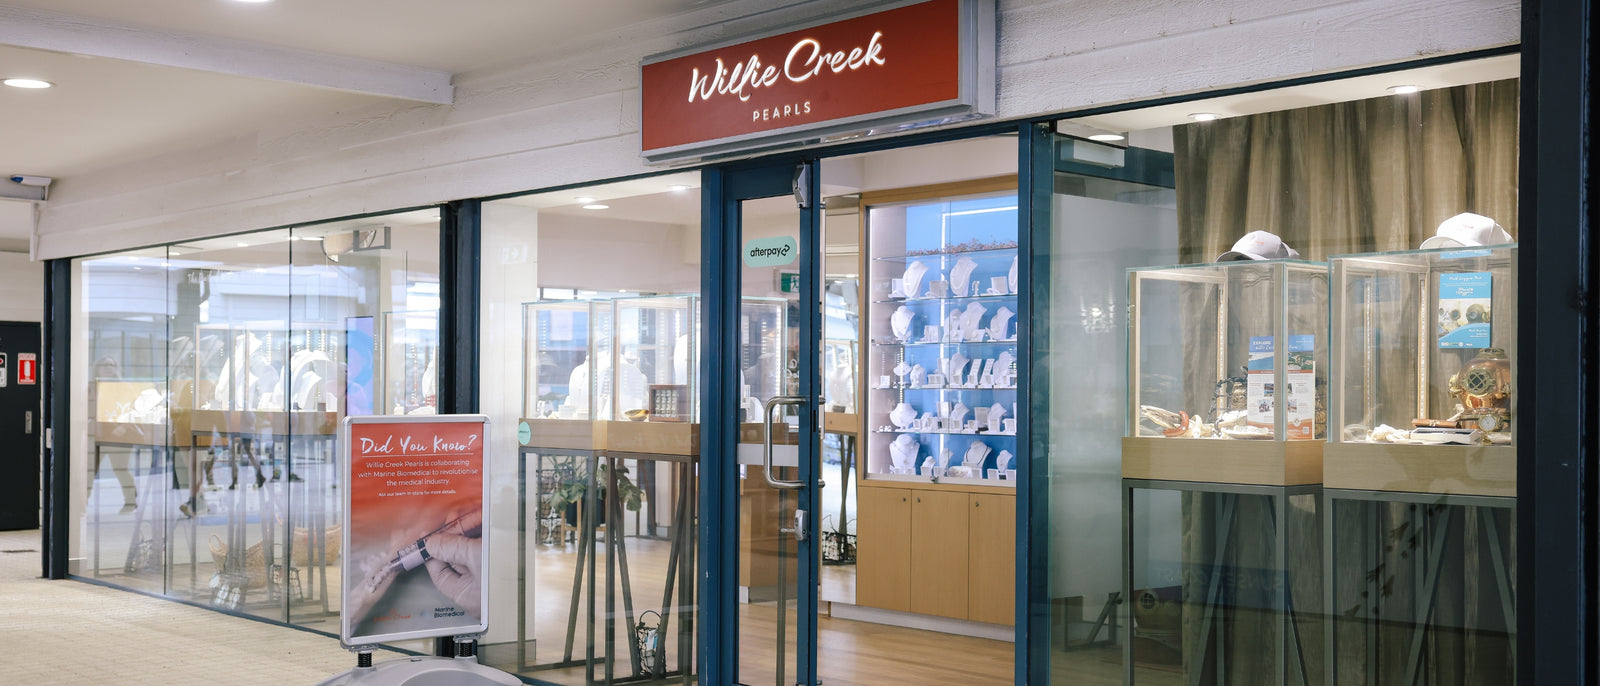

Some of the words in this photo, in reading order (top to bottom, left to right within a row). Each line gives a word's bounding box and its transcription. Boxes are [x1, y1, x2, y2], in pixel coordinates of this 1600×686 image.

[688, 54, 783, 103] Willie
[783, 31, 886, 83] Creek
[752, 101, 812, 123] PEARLS
[750, 247, 782, 258] afterpay
[360, 435, 394, 454] Did
[400, 435, 428, 454] You
[433, 434, 478, 453] Know?
[404, 460, 424, 468] Pearls
[430, 459, 470, 467] collaborating
[396, 469, 431, 477] Biomedical
